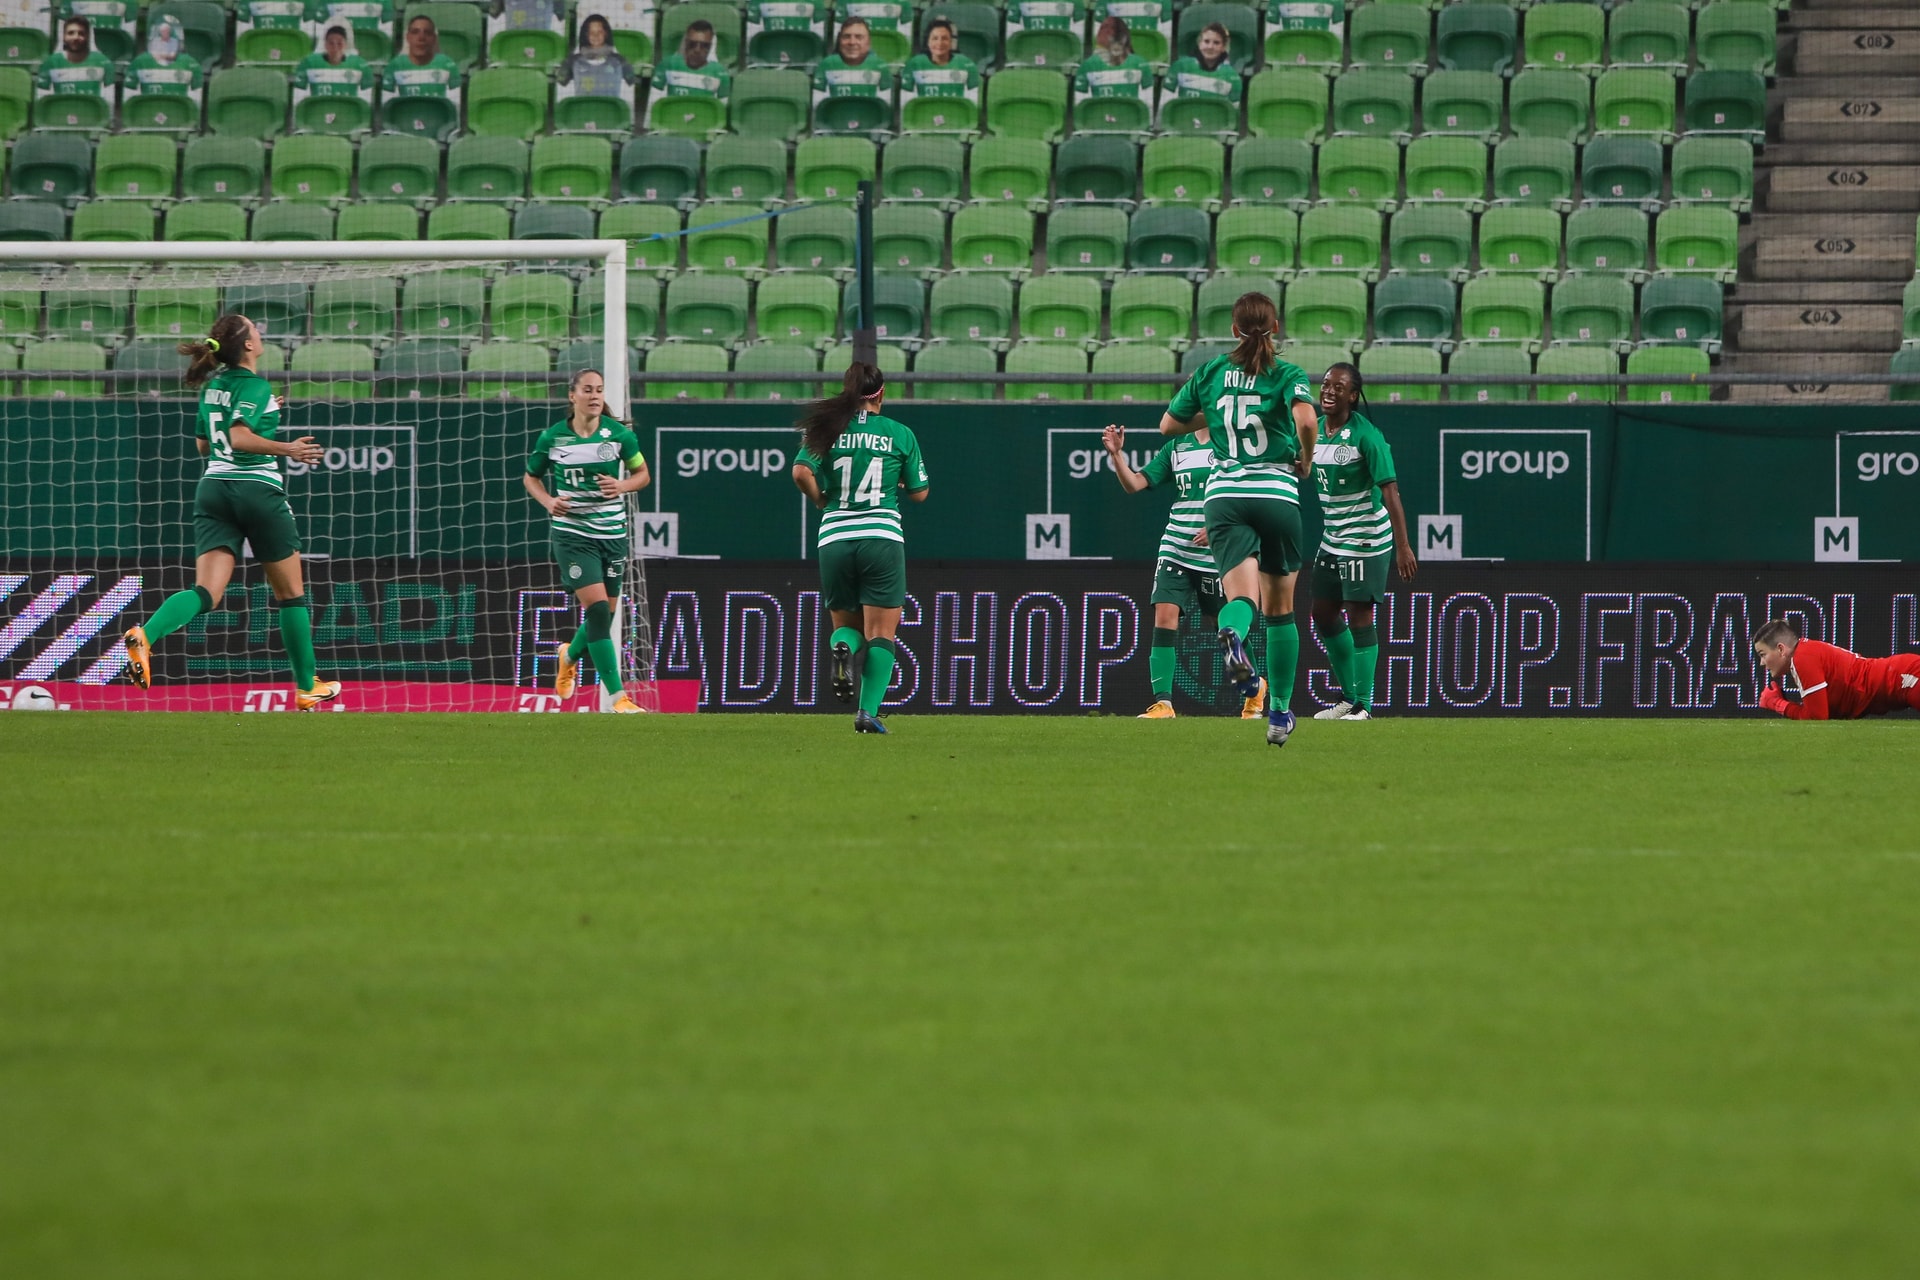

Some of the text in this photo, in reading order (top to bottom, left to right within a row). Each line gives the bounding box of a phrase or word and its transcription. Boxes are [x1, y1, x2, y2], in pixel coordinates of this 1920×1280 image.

[1867, 36, 1882, 48] 08
[1854, 103, 1869, 115] 07
[1840, 172, 1855, 184] 06
[1827, 240, 1842, 252] 05
[1813, 311, 1829, 323] 04
[209, 412, 234, 461] 5
[1216, 394, 1268, 459] 15
[676, 448, 786, 478] group
[1068, 449, 1160, 479] grou
[1460, 450, 1570, 480] group
[833, 456, 886, 509] 14
[643, 521, 670, 548] M
[1035, 523, 1061, 549] M
[1427, 523, 1453, 550] M
[1823, 525, 1850, 552] M
[1348, 559, 1365, 582] 11
